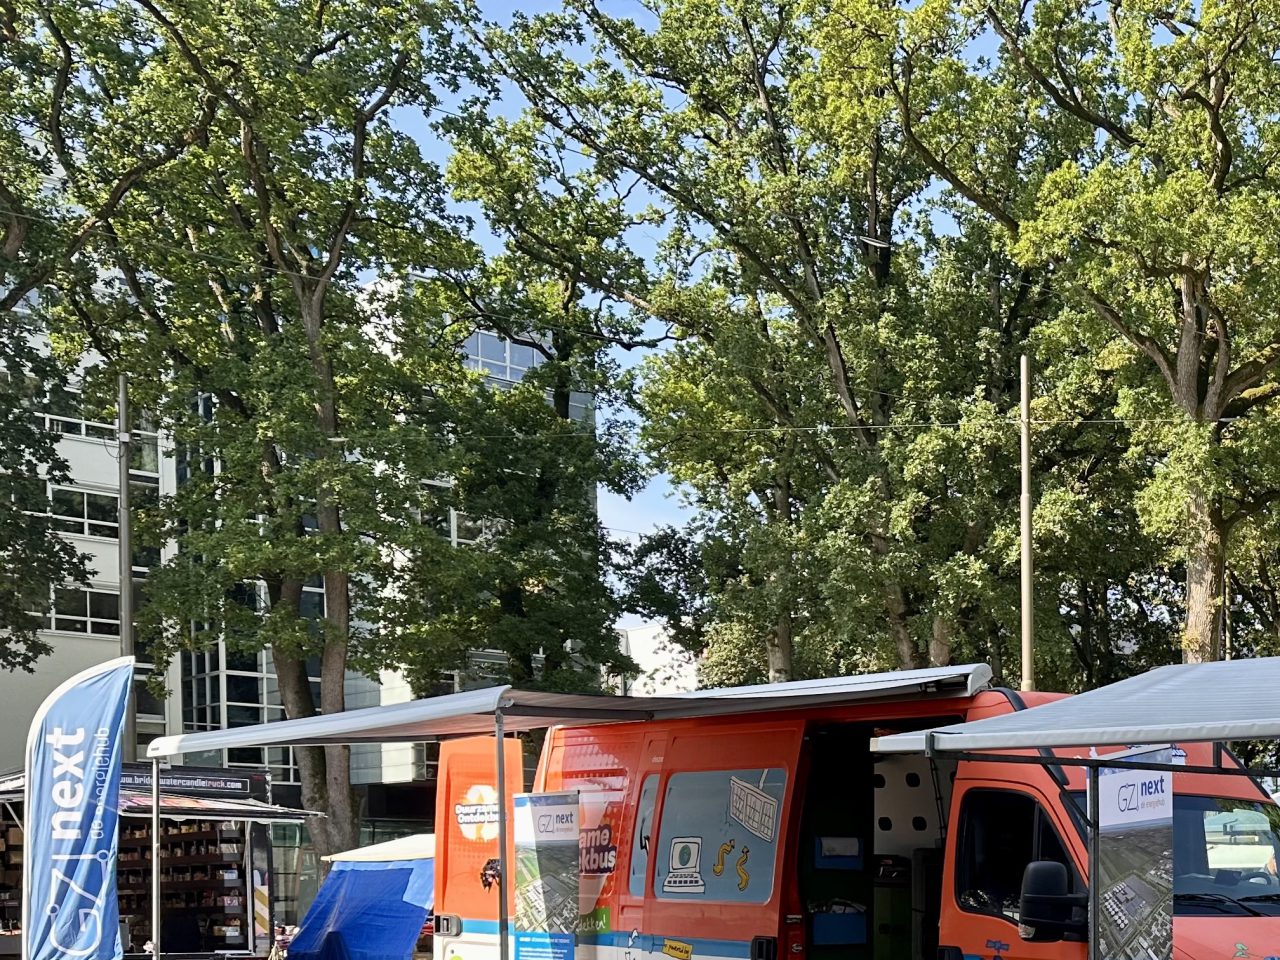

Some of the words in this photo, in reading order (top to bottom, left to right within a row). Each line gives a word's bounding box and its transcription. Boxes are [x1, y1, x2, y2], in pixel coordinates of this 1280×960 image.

[46, 727, 85, 840] next
[1141, 776, 1164, 797] next
[556, 812, 573, 824] next
